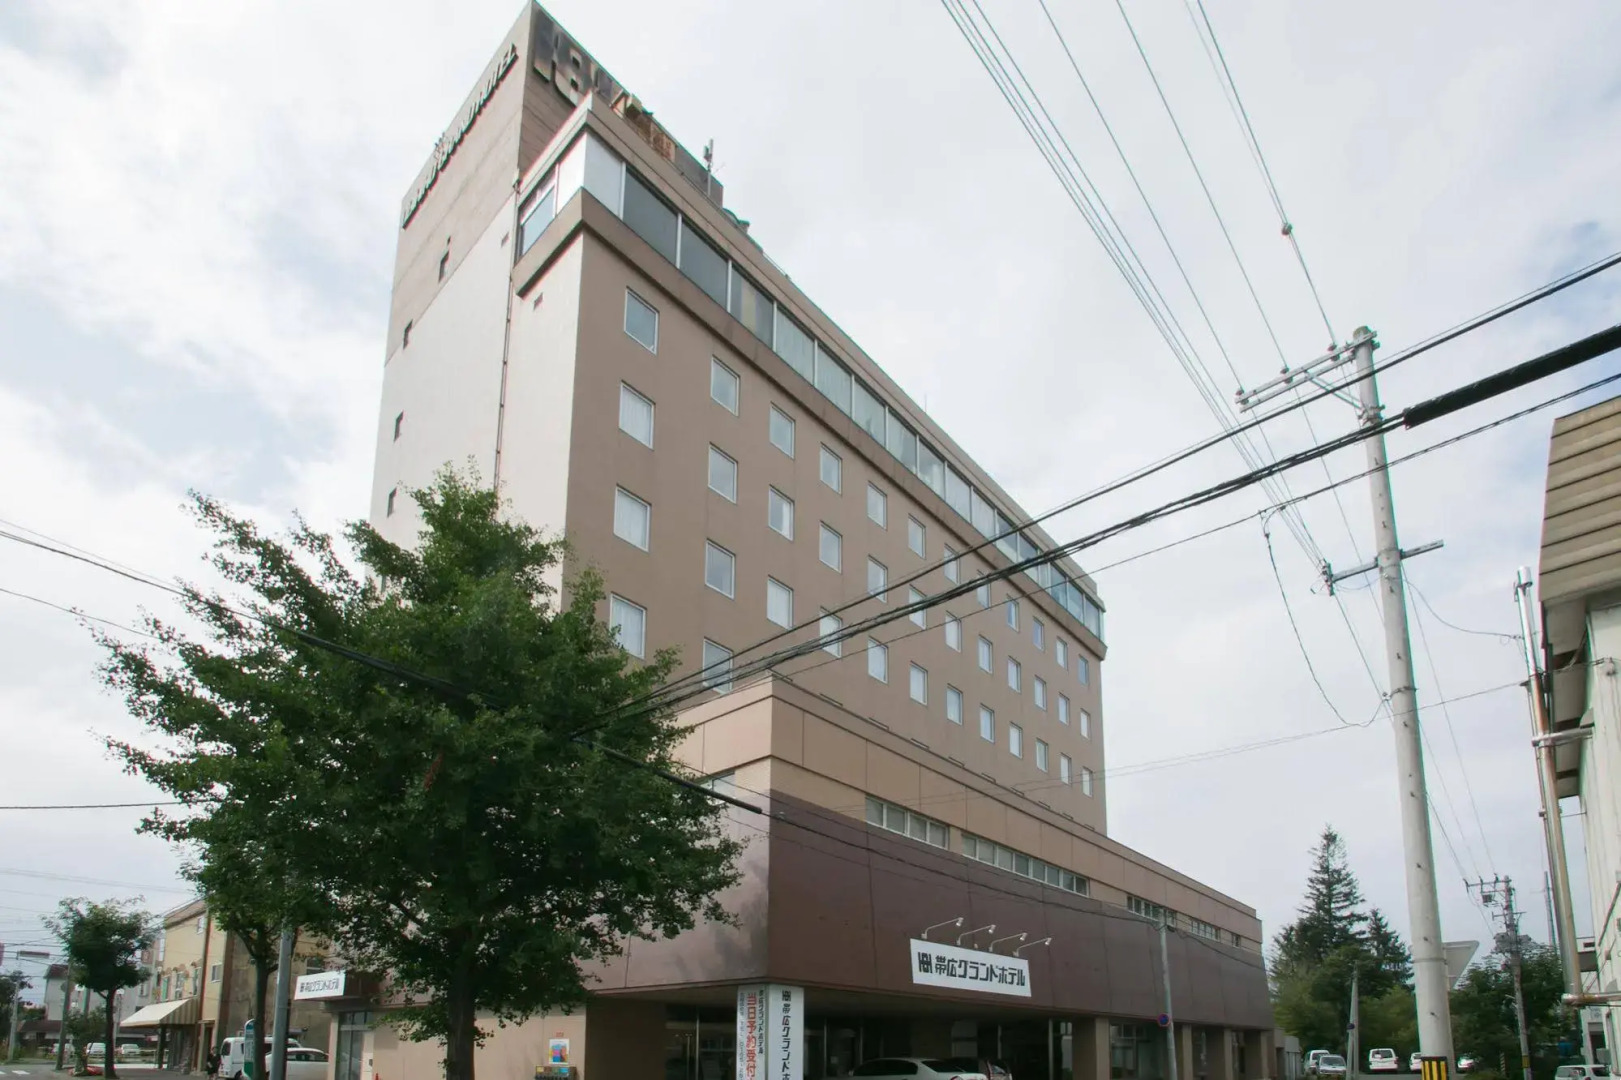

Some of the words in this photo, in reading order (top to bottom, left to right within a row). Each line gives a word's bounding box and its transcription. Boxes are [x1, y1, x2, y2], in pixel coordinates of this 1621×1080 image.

[935, 954, 1026, 987] 帯広グランドホテル
[746, 992, 757, 1080] 当日予約受付
